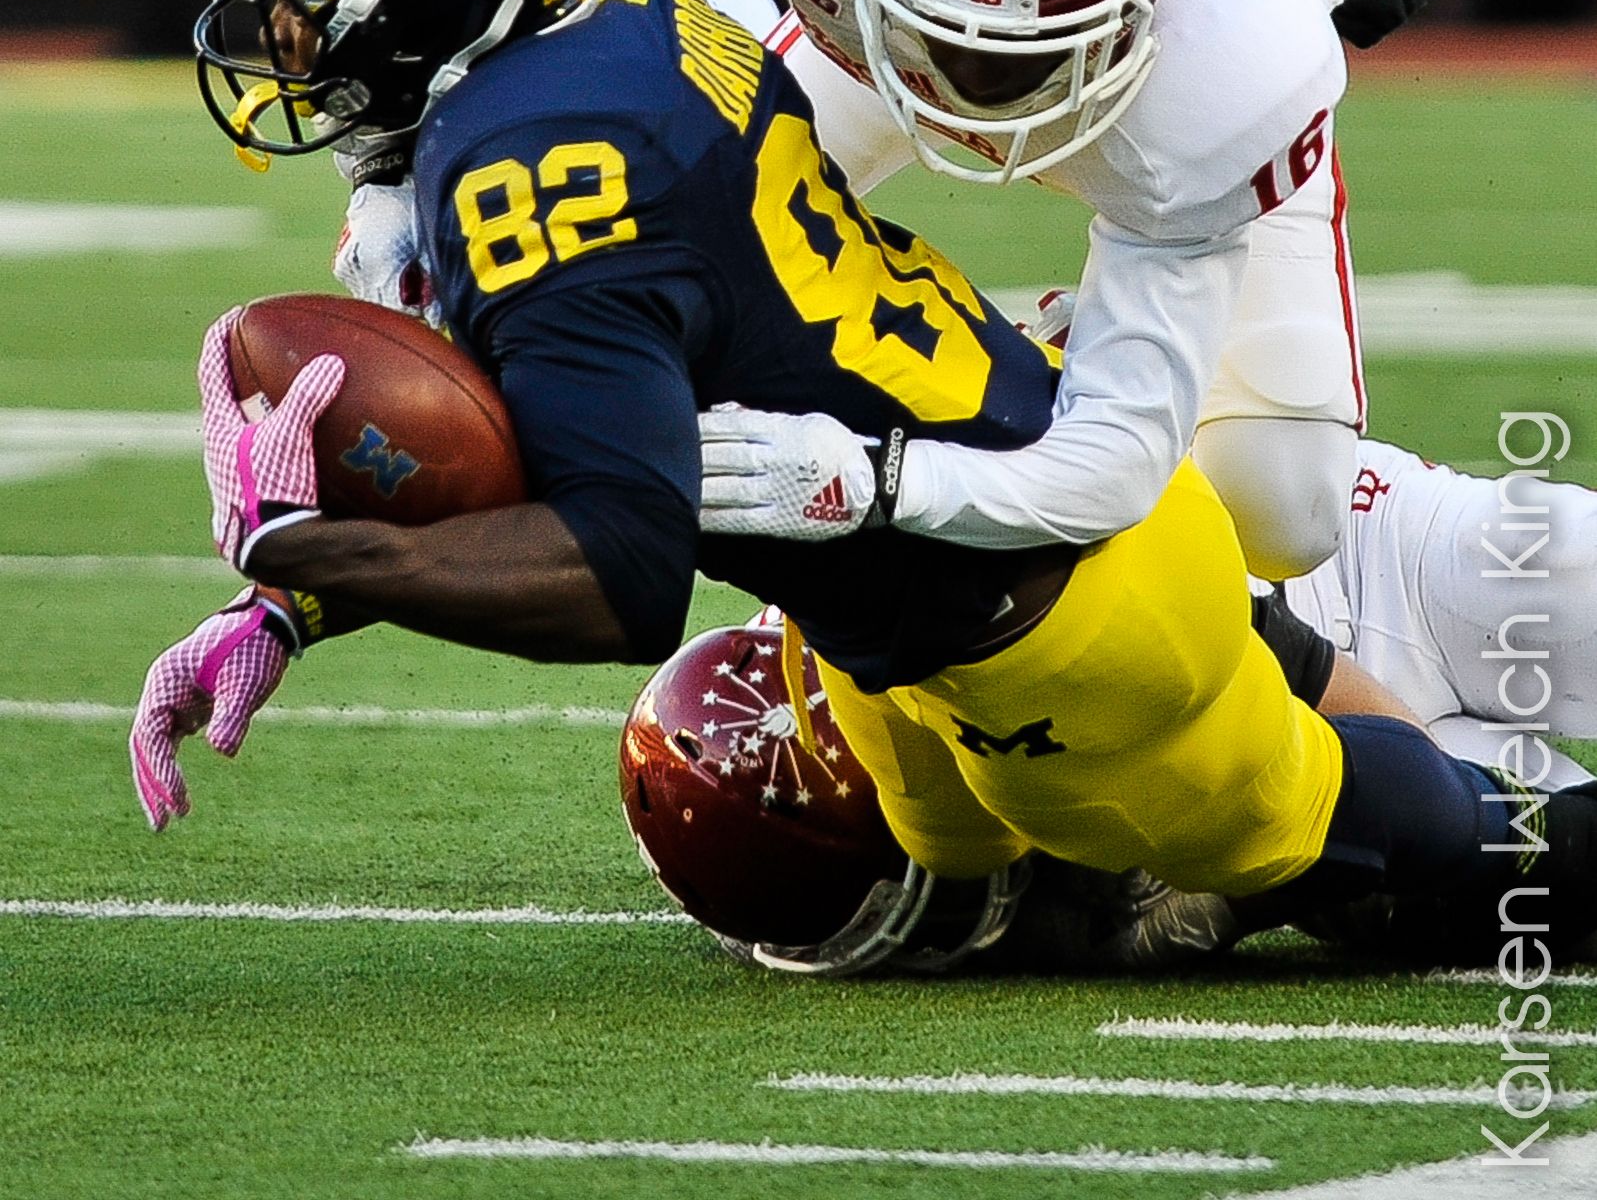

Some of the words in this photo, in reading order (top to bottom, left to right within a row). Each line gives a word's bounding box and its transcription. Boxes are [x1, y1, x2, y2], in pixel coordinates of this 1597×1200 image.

[1250, 108, 1328, 217] 16
[455, 142, 637, 293] 82
[885, 427, 904, 495] adizero
[803, 503, 853, 523] adidas
[949, 712, 1067, 758] M
